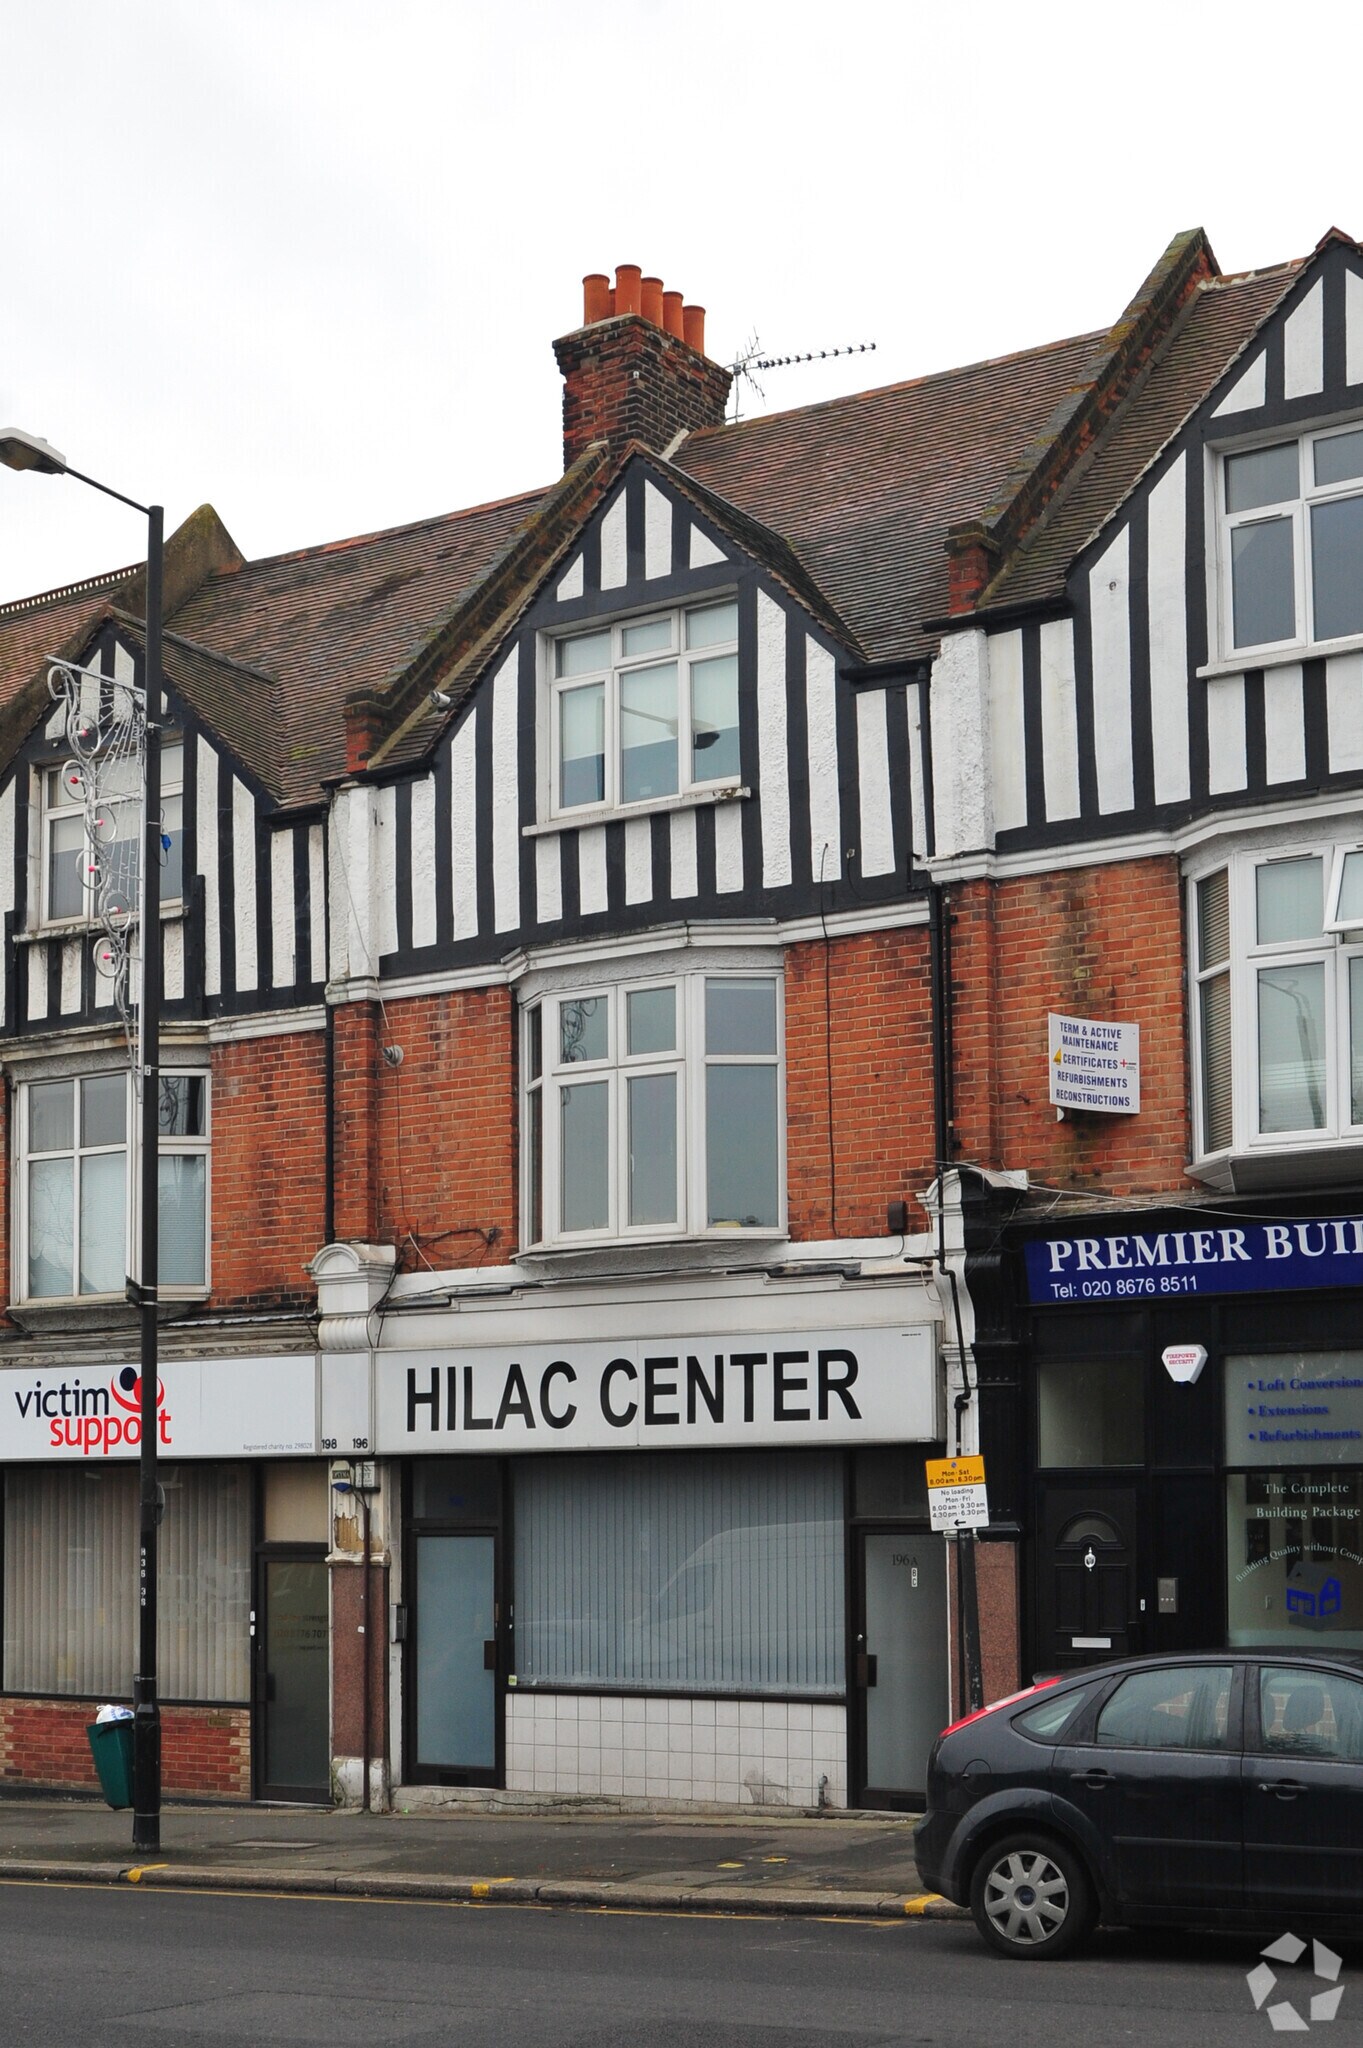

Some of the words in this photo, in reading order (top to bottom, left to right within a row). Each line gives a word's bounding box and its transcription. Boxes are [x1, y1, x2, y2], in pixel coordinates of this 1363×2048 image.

[1060, 1022, 1079, 1035] TERM
[1082, 1026, 1087, 1036] &
[1091, 1027, 1122, 1039] ACTIVE
[1062, 1035, 1119, 1051] MAINTENANCE
[1063, 1054, 1118, 1070] CERTIFICATES
[1057, 1070, 1128, 1088] REFURBISHMENTS
[1056, 1089, 1130, 1107] RECONSTRUCTIONS
[1046, 1228, 1252, 1272] PREMIER
[1050, 1282, 1078, 1299] Tel:
[1082, 1280, 1111, 1297] 020
[1116, 1277, 1156, 1296] 8676
[1160, 1275, 1197, 1293] 8511
[406, 1360, 578, 1432] HILAC
[599, 1349, 863, 1428] CENTER
[1257, 1378, 1285, 1391] Loft
[1290, 1376, 1363, 1390] Conversion
[14, 1378, 110, 1419] victim
[1258, 1404, 1329, 1417] Extensions
[50, 1408, 172, 1455] suppot
[1259, 1428, 1362, 1442] Refurbishments
[268, 1443, 284, 1451] charity
[321, 1438, 338, 1449] 198
[352, 1437, 368, 1449] 196
[1264, 1483, 1287, 1494] The
[1291, 1482, 1350, 1497] Complete
[1256, 1507, 1308, 1520] Building
[1312, 1506, 1361, 1520] Package
[1235, 1556, 1270, 1583] Building
[1269, 1544, 1301, 1560] Quality
[1303, 1542, 1338, 1554] without
[912, 1569, 917, 1577] B
[912, 1578, 917, 1586] C
